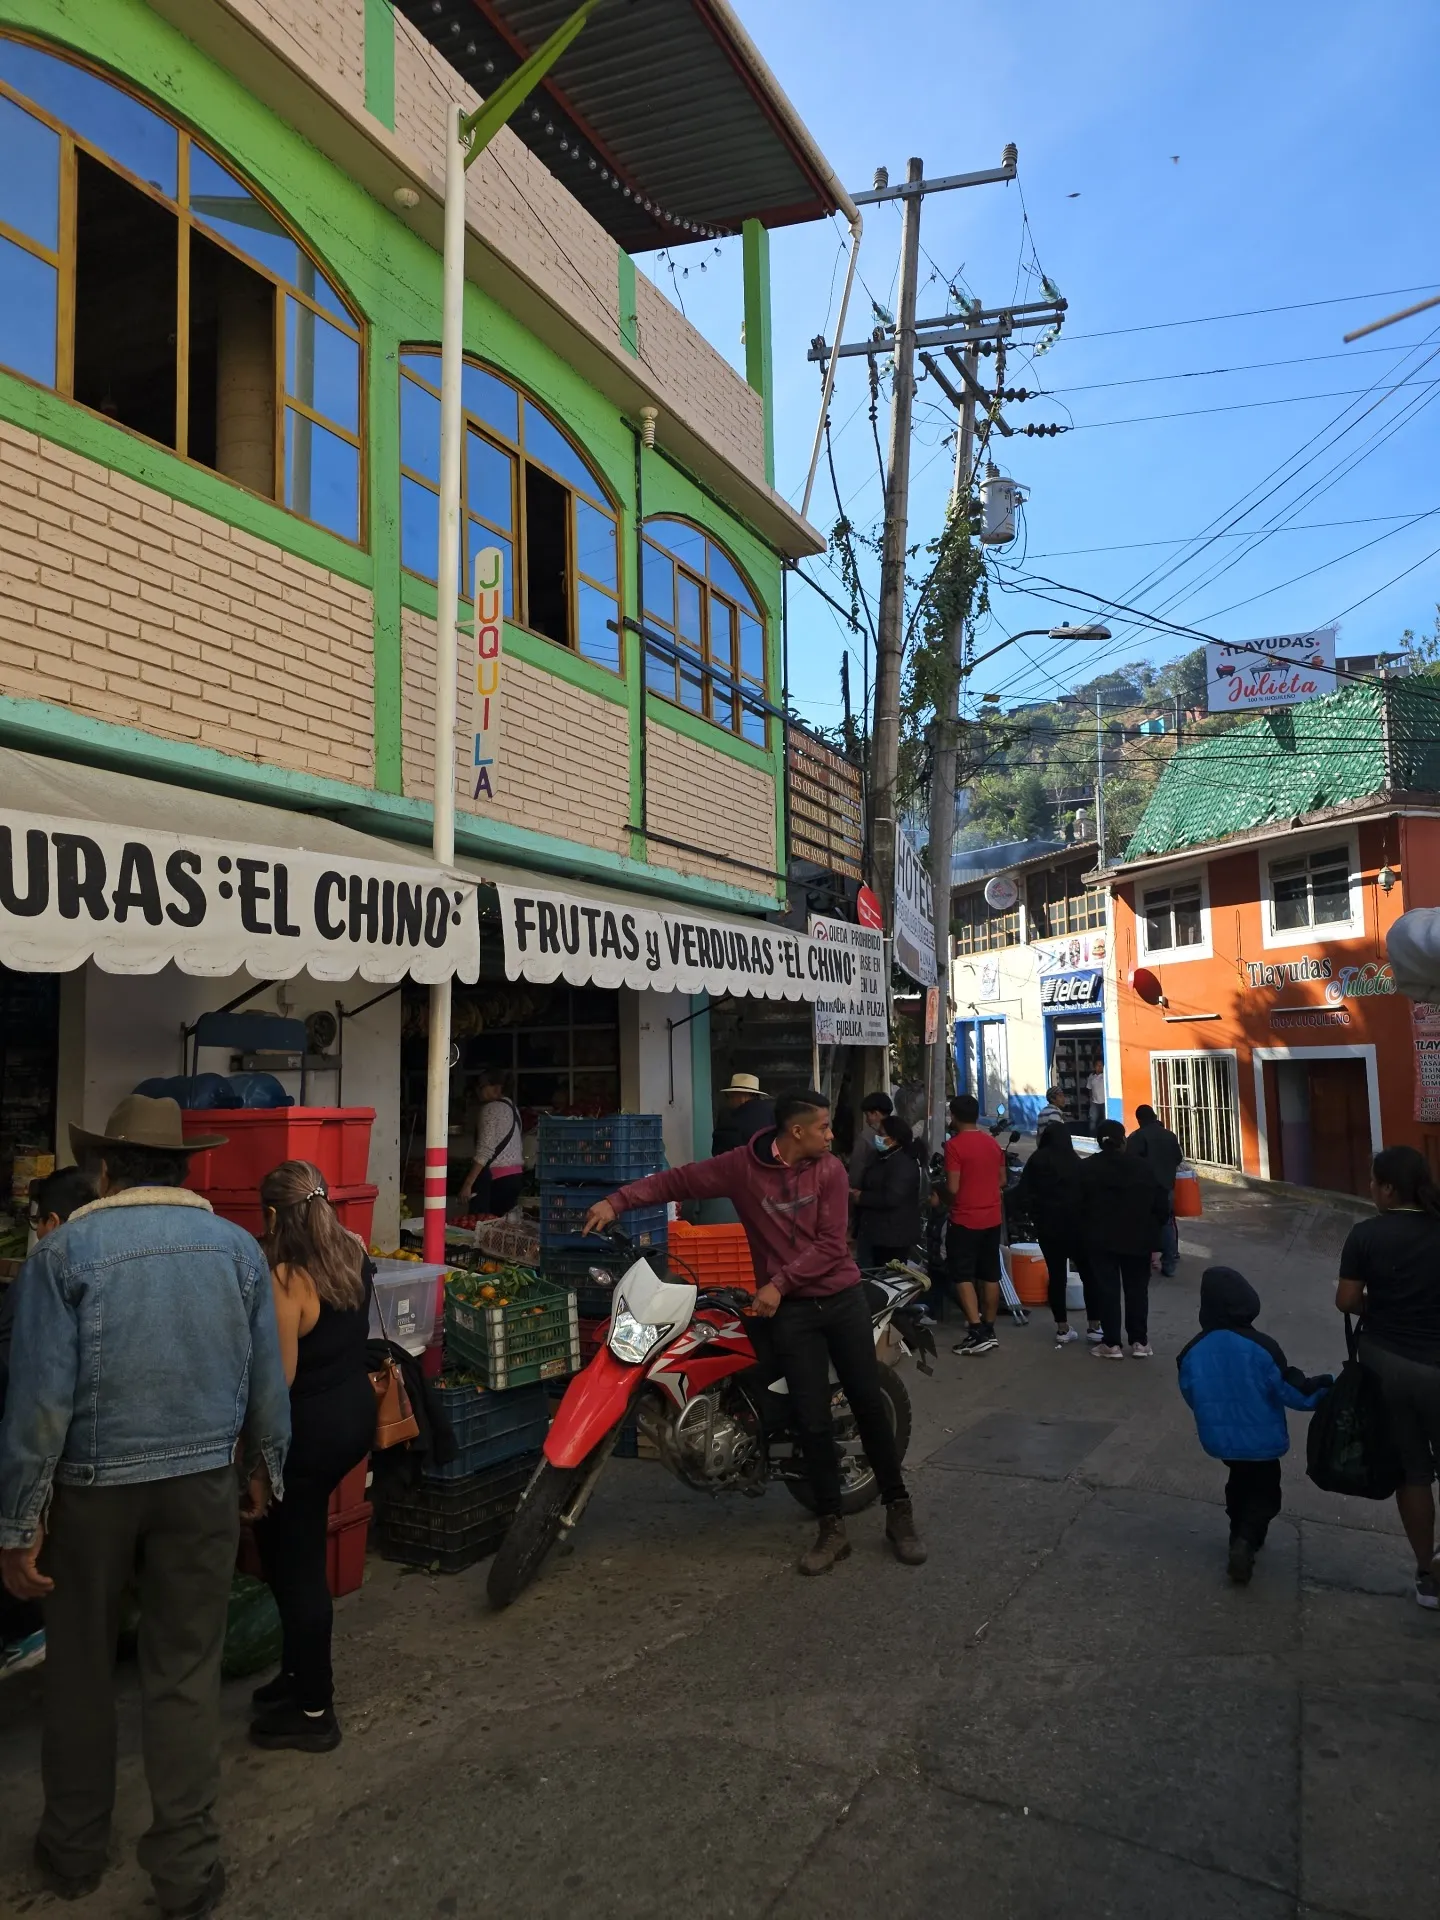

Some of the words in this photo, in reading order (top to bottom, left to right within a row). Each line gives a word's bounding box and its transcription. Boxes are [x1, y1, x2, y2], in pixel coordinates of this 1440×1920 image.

[1223, 637, 1315, 656] TLAYUDAS
[473, 555, 499, 799] JUQUILA
[1228, 672, 1318, 702] Julieta
[791, 772, 801, 790] LES
[897, 830, 935, 927] HOTEL
[514, 897, 640, 961] FRUTAS
[644, 929, 662, 972] y
[664, 920, 775, 977] VERDURAS
[828, 924, 848, 944] QUEDA
[851, 929, 881, 951] PROHIBIDO
[873, 957, 880, 972] EN
[1247, 956, 1332, 990] Tlayudas
[870, 979, 877, 994] LA
[1053, 973, 1097, 1002] telcel
[1325, 962, 1397, 1005] Julieta
[849, 999, 855, 1015] A
[867, 1000, 885, 1017] PLAZA
